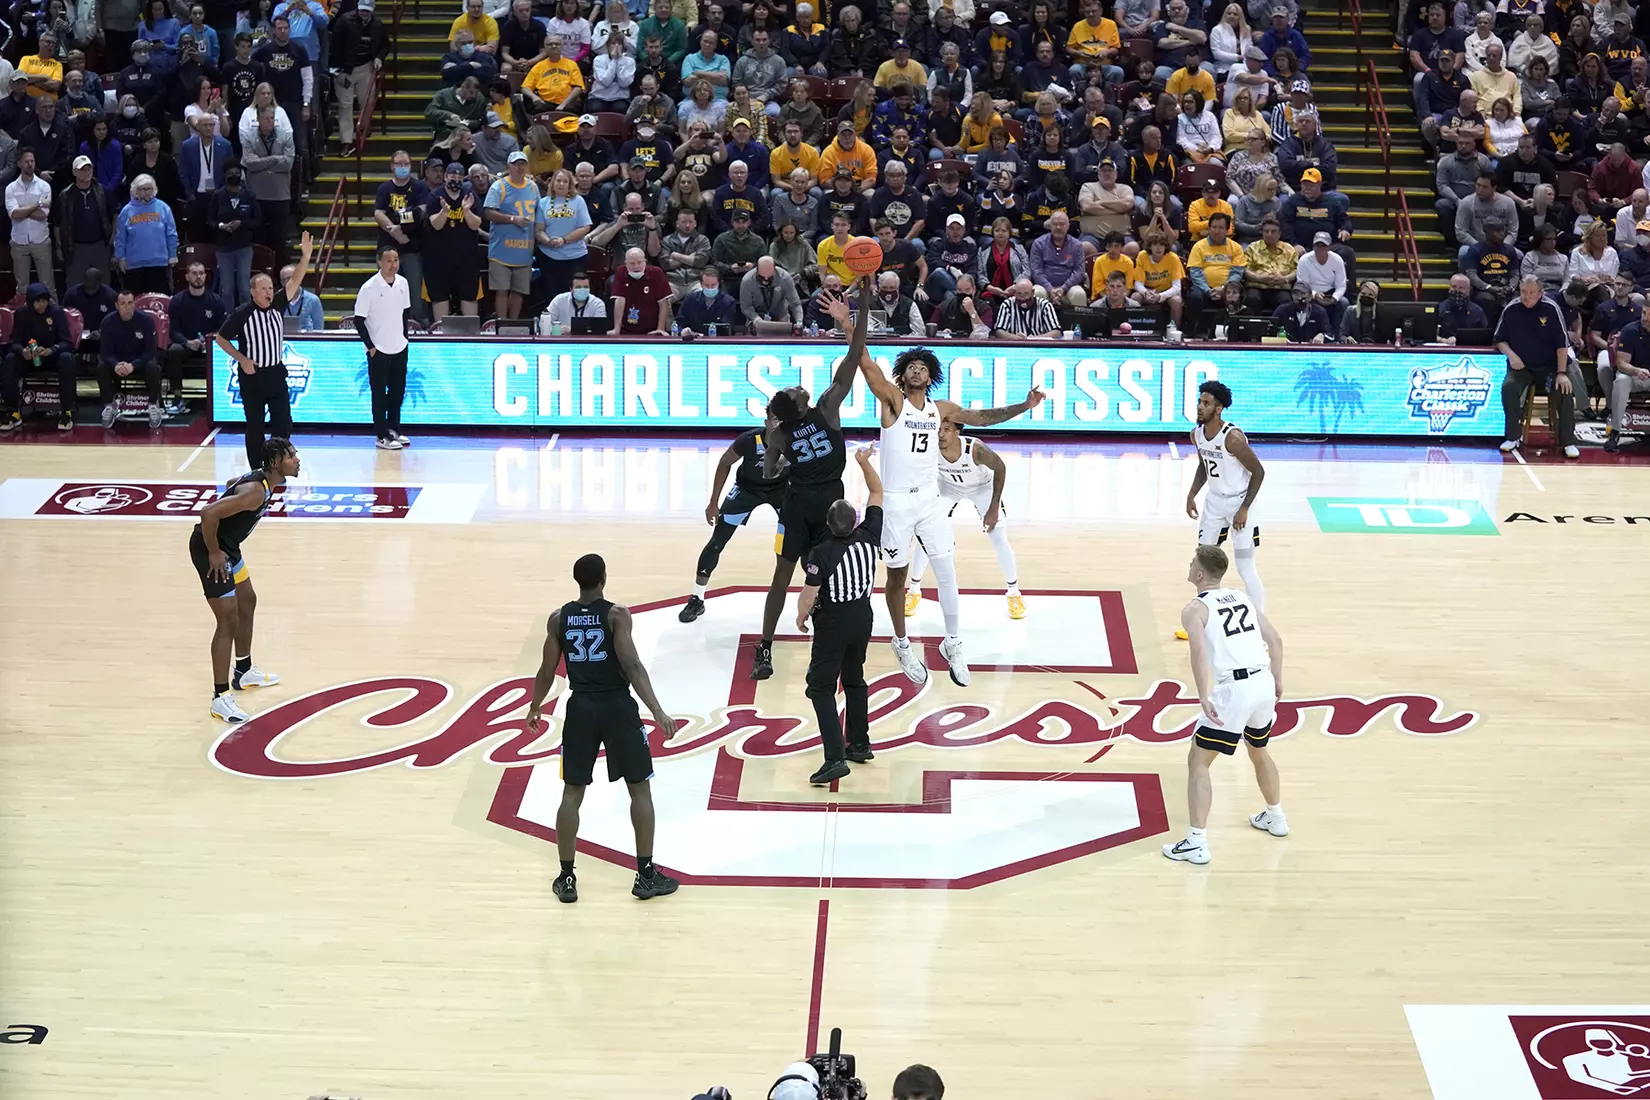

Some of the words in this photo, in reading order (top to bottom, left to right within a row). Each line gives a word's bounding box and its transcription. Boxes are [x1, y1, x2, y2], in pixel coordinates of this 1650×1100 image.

[515, 199, 536, 222] 15
[493, 353, 893, 419] CHARLESTO
[1411, 388, 1486, 401] Charleston
[1421, 400, 1472, 411] Classic
[791, 430, 834, 463] 35
[911, 433, 929, 453] 13
[950, 473, 964, 483] 11
[165, 489, 379, 502] Shners
[1327, 503, 1472, 528] TD
[1503, 512, 1650, 524] Aren
[567, 614, 602, 626] MORSELL
[1217, 604, 1255, 637] 22
[564, 628, 608, 662] 32
